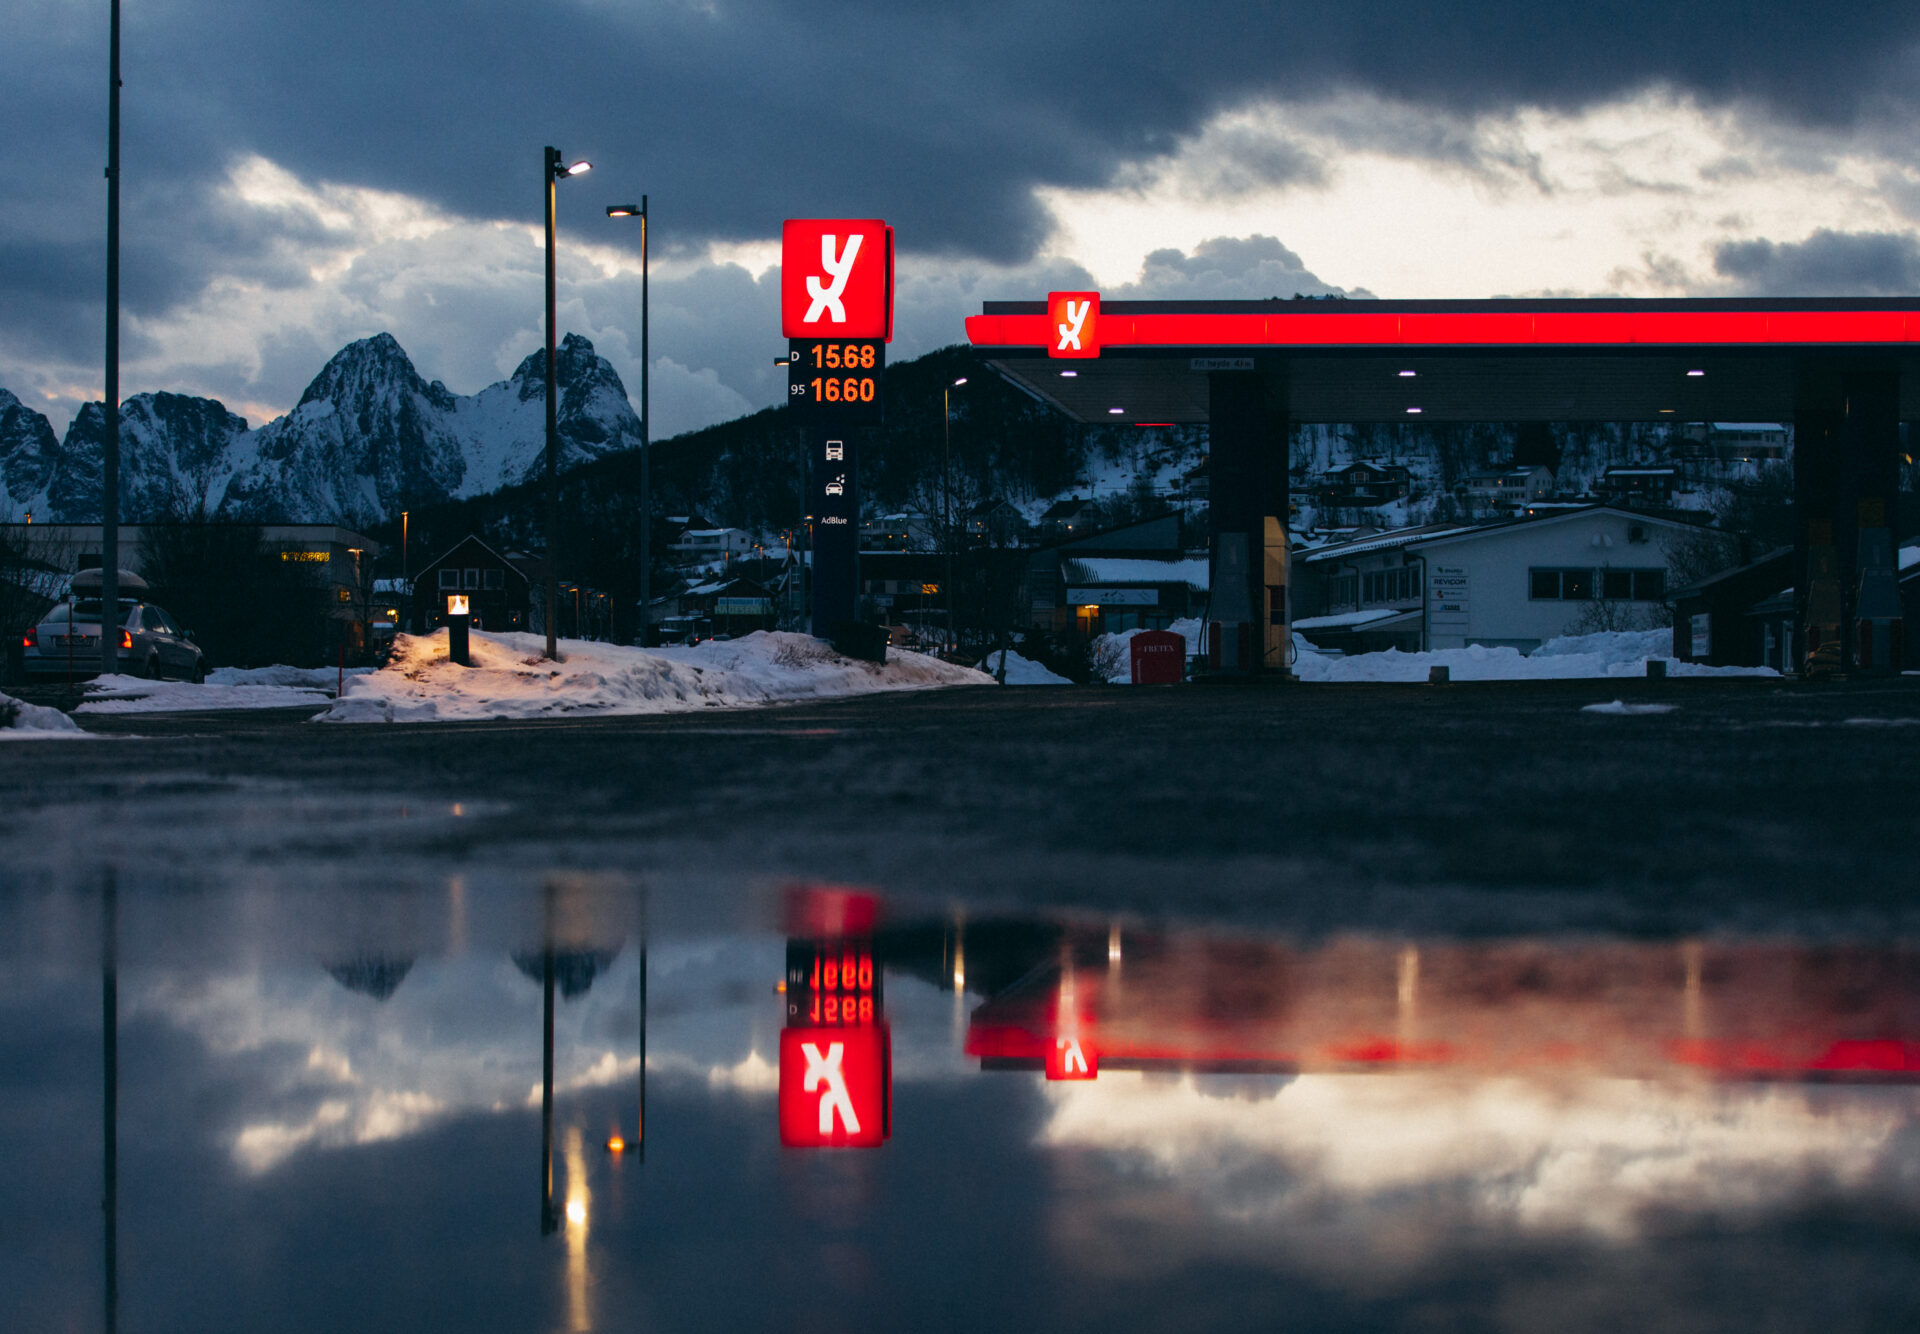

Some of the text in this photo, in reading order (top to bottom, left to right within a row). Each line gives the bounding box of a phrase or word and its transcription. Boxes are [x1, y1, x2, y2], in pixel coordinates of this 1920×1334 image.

[791, 344, 875, 369] D 15.68
[791, 377, 875, 403] 95 16.60
[820, 515, 848, 525] AdBlue
